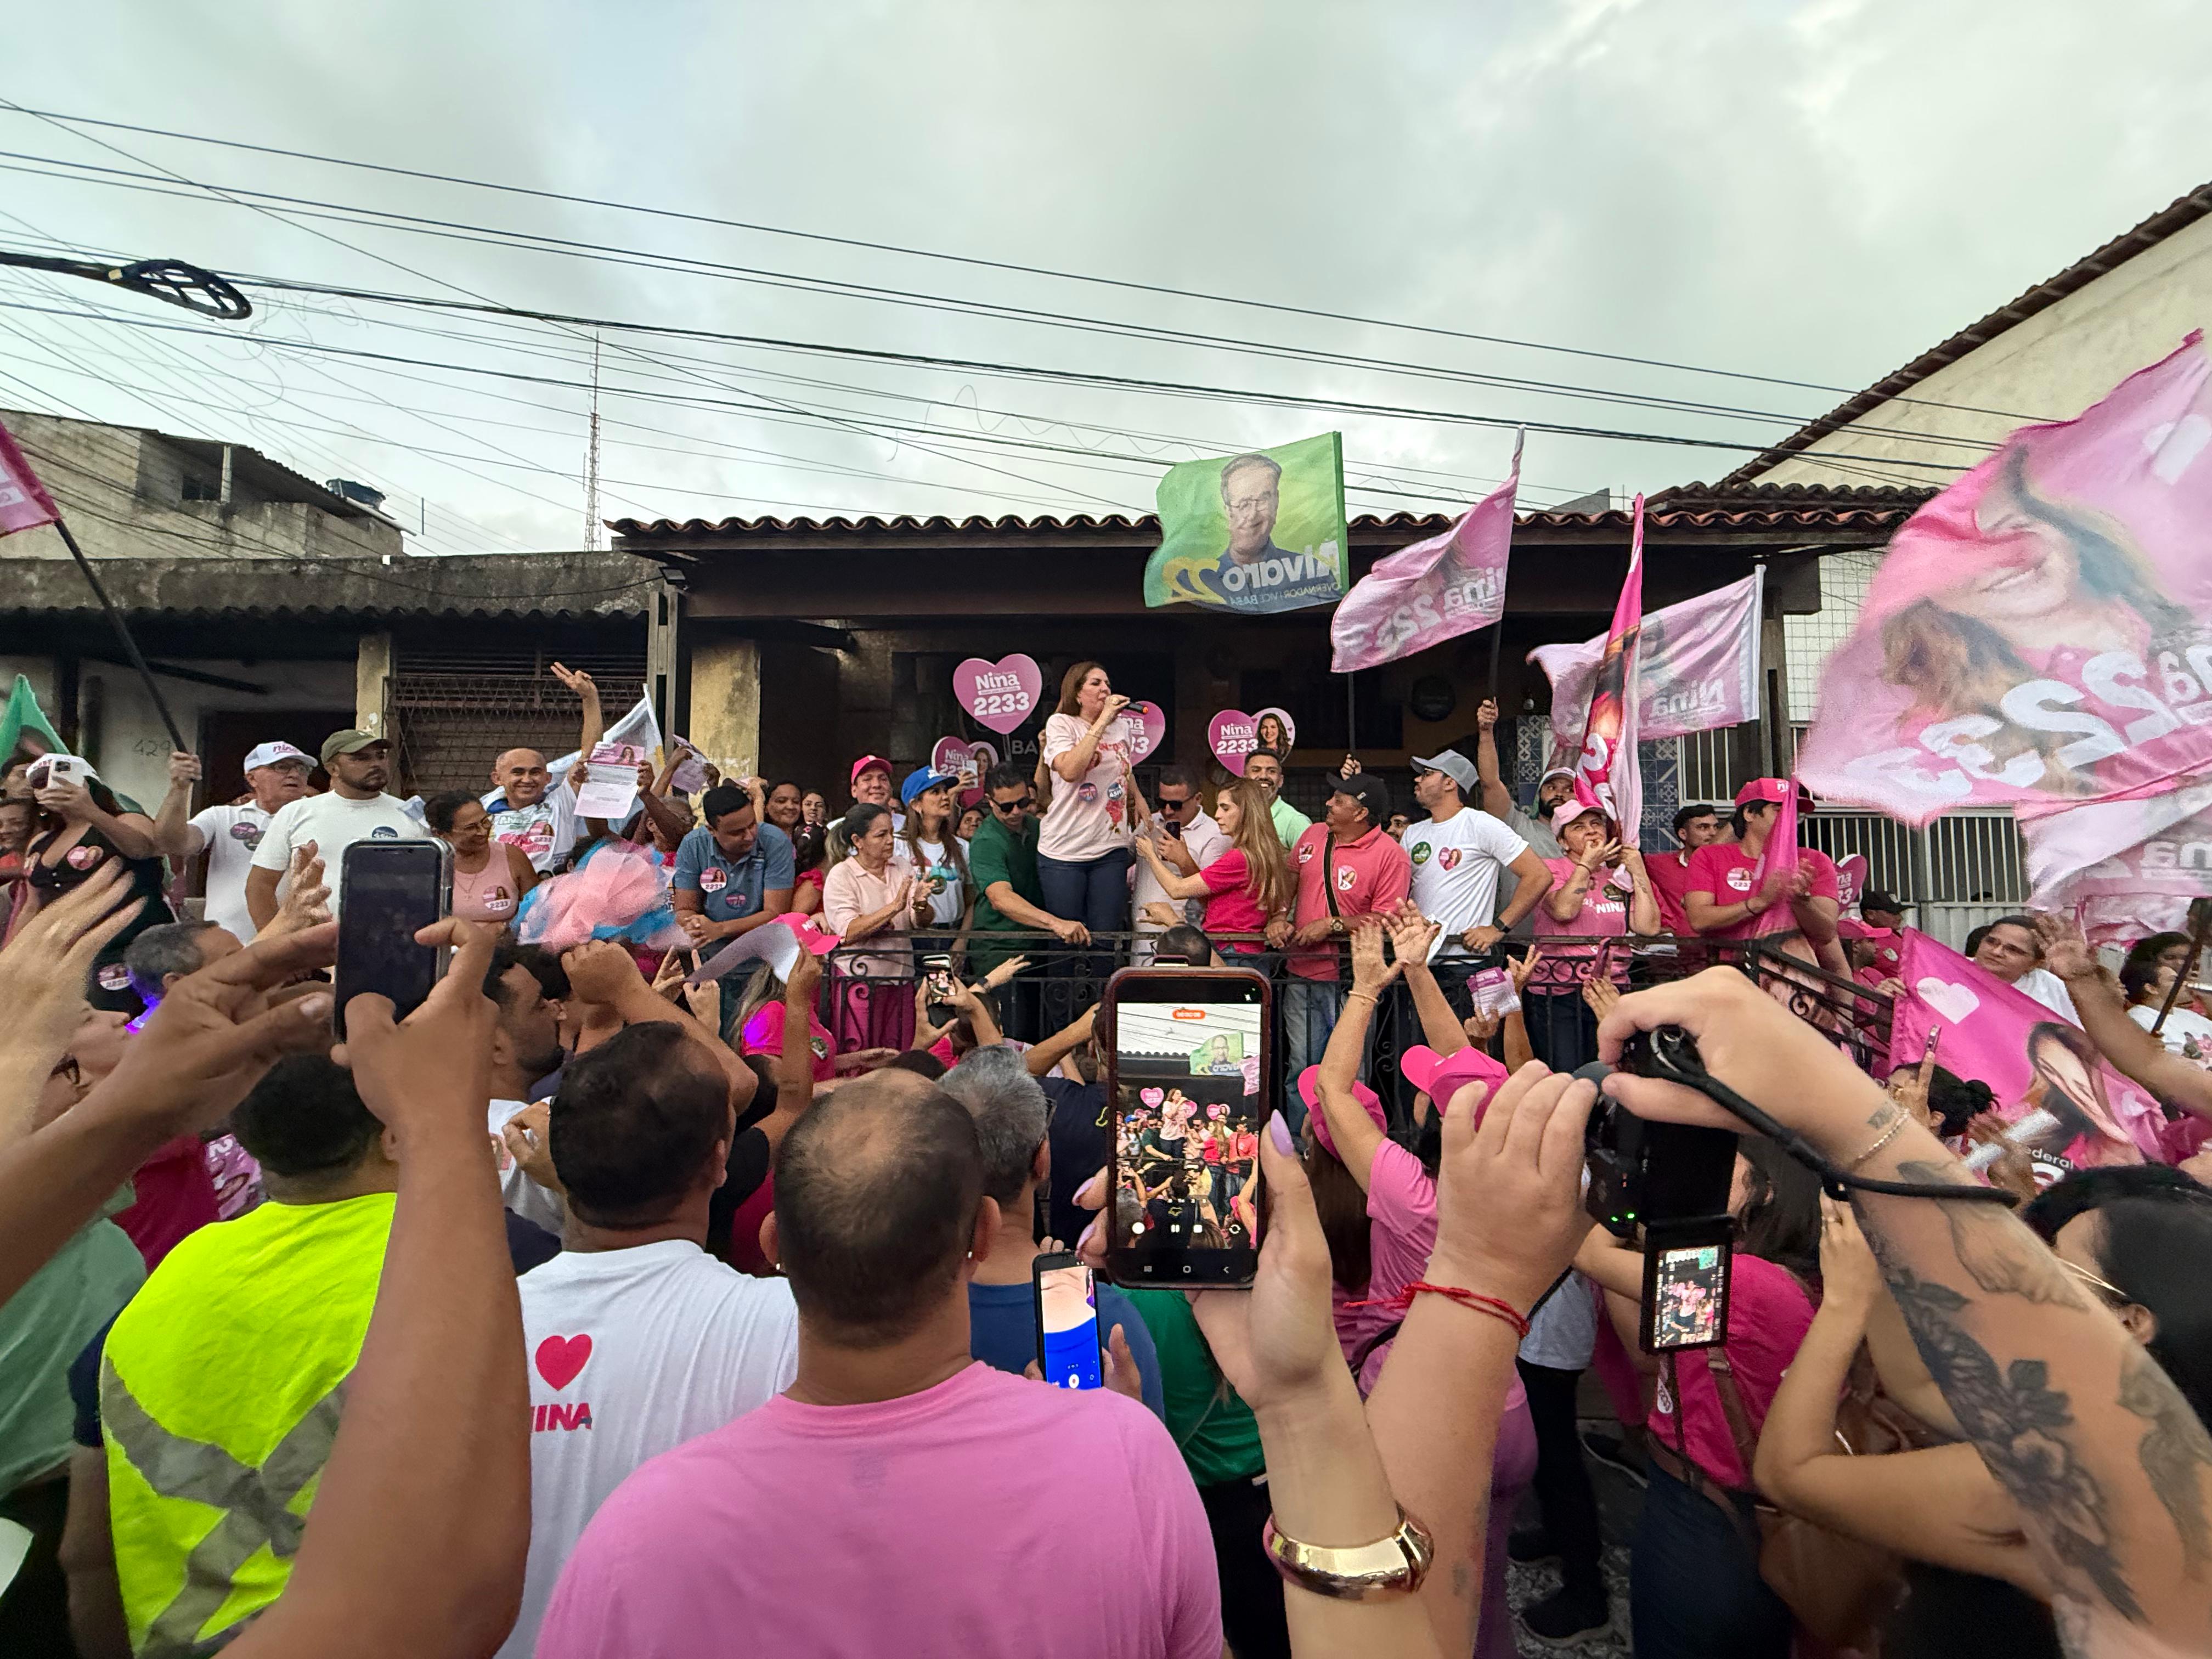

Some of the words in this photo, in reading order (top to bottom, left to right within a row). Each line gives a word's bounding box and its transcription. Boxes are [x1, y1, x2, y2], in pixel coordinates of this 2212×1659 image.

[974, 672, 1020, 691] Nina
[974, 691, 1030, 716] 2233
[1220, 723, 1253, 736] Nina
[133, 739, 171, 758] 429
[1216, 738, 1259, 755] 2233
